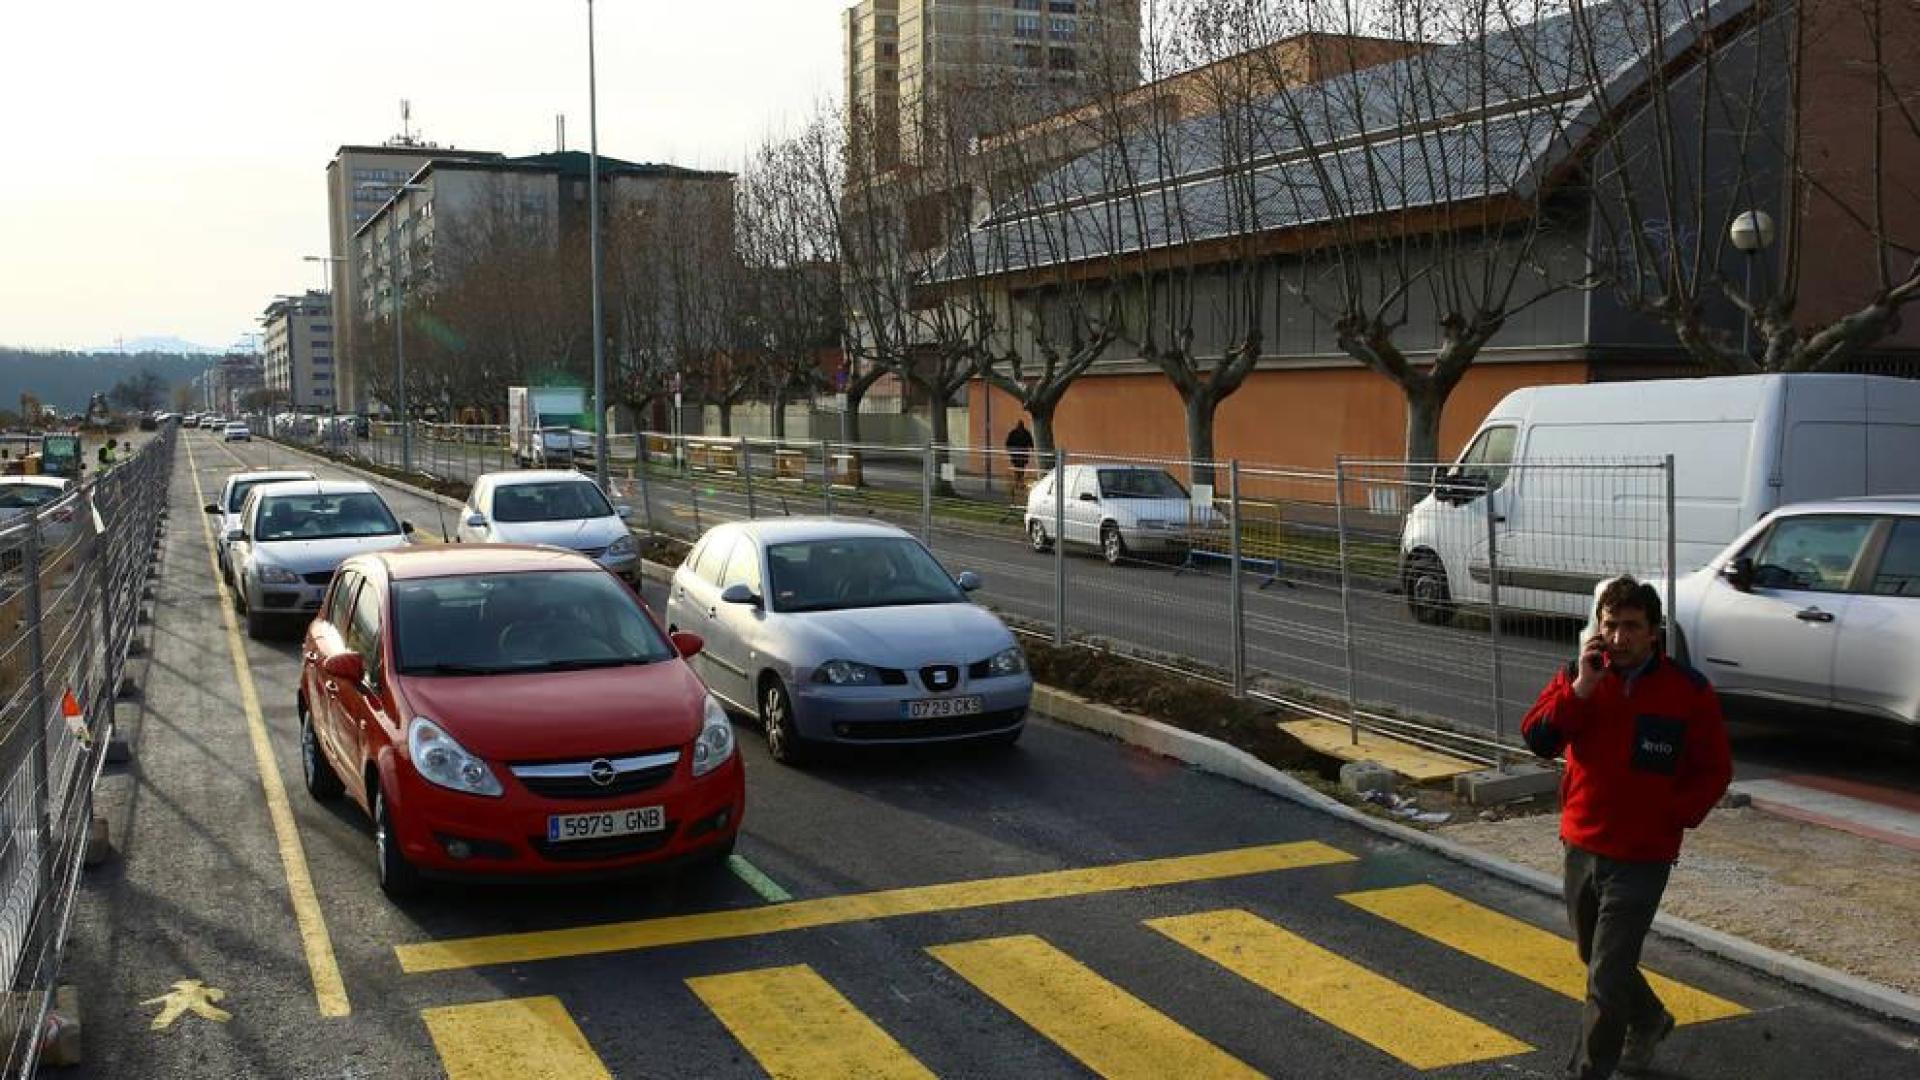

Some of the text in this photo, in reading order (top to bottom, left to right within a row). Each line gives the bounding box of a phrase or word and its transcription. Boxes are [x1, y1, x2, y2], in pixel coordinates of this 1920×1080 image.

[911, 700, 951, 716] 0729
[565, 808, 660, 836] 5979 GNB
